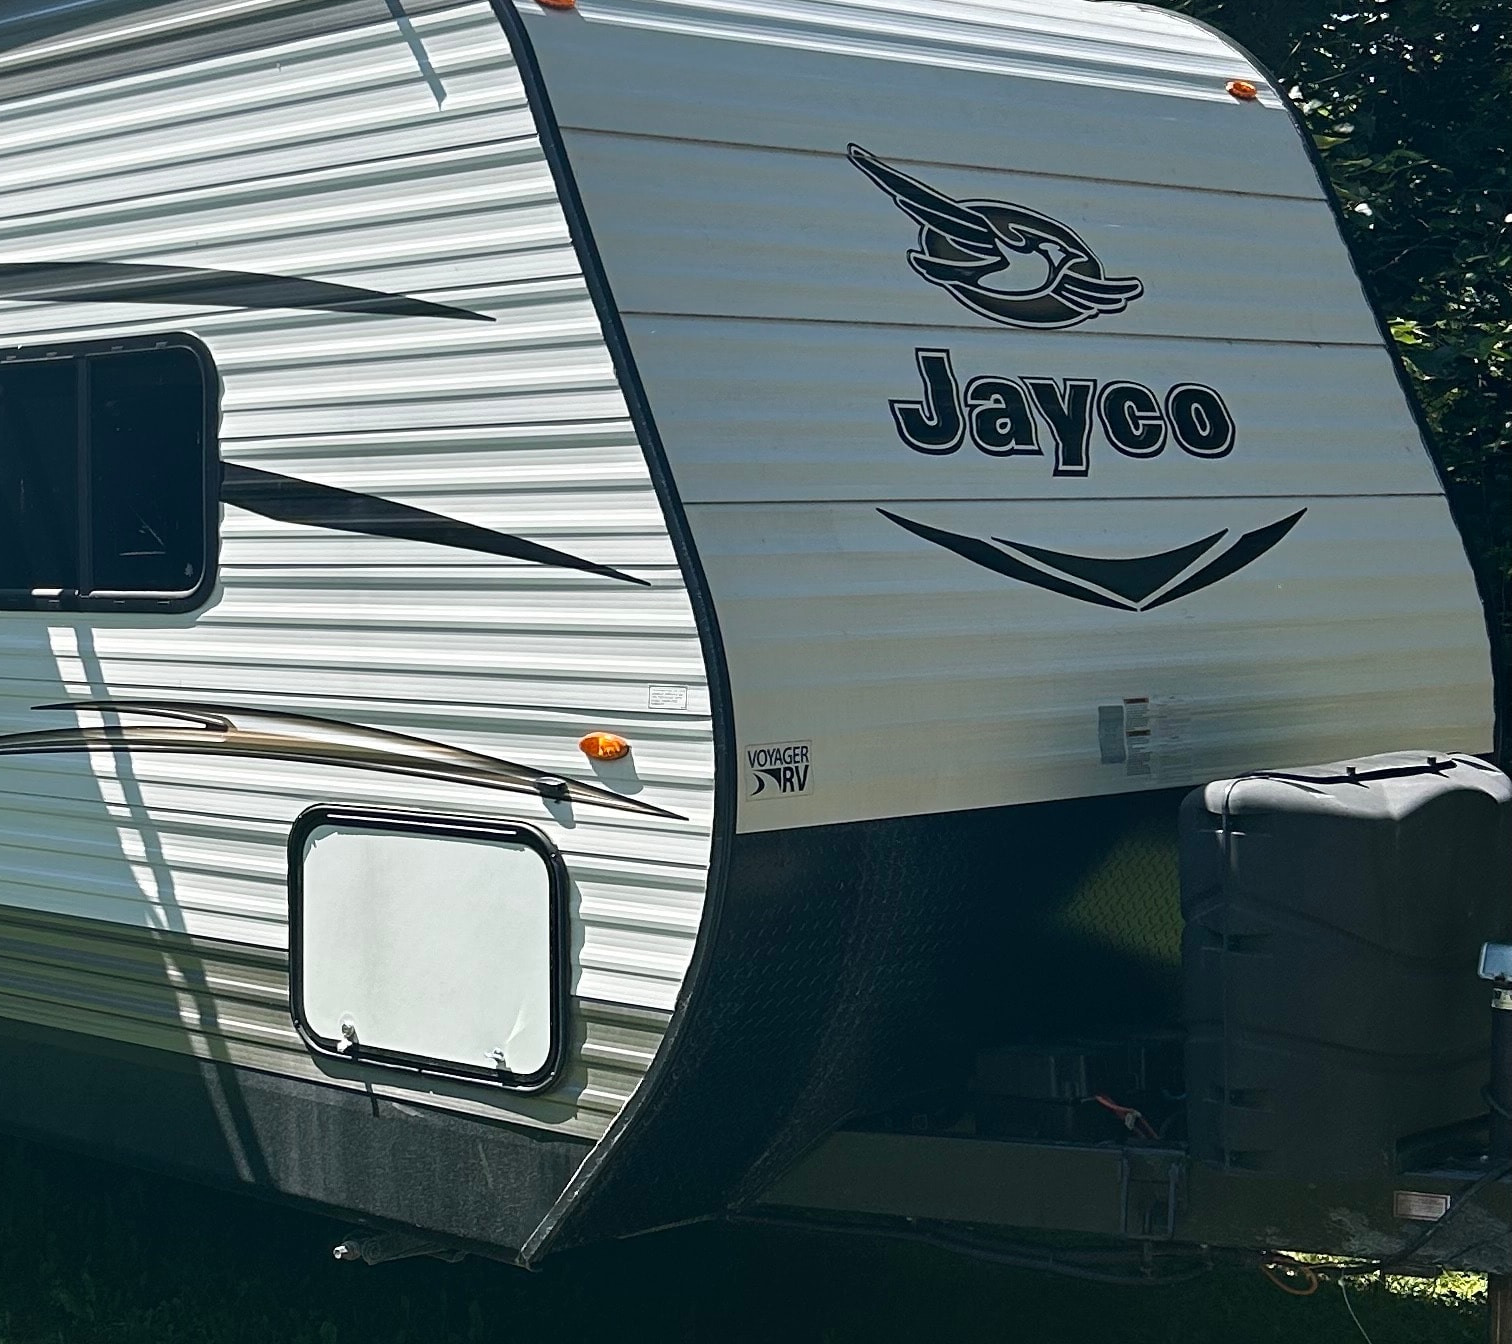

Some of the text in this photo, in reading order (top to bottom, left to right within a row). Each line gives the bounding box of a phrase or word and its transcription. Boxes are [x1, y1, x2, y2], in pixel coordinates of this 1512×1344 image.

[888, 347, 1236, 477] Jayco
[747, 745, 810, 768] VOYAGER
[782, 764, 810, 793] RV
